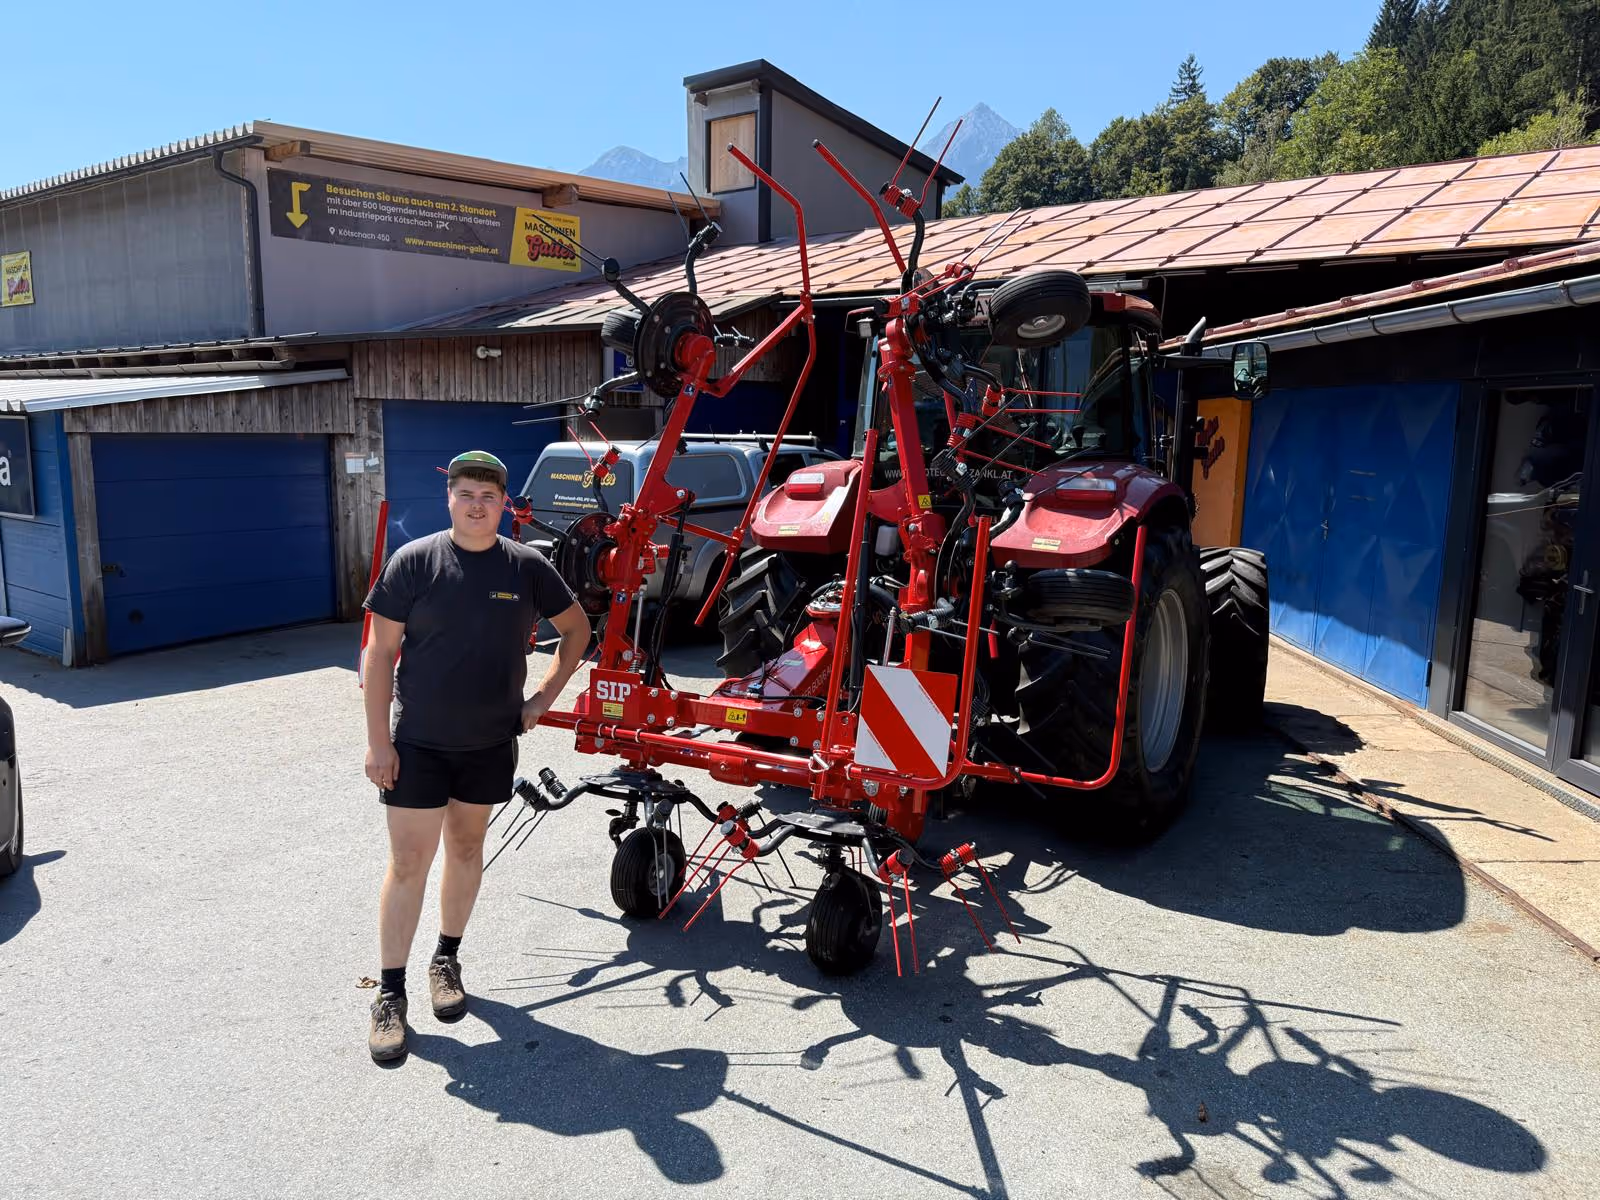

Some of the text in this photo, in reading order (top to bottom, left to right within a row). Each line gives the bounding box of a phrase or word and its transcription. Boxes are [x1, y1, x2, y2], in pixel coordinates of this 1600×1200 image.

[326, 184, 497, 217] Besuchen Sie uns auch am 2. Standort
[326, 196, 501, 228] mit über 500 lagernden Maschinen und Geräten
[340, 208, 393, 223] Industriepark
[393, 213, 433, 228] Kötschach
[338, 228, 390, 242] Kötschach 450
[524, 222, 576, 237] MASCHINEN
[404, 237, 498, 254] www.maschinen-gailer.at
[550, 473, 582, 482] MASCHINEN
[596, 680, 631, 702] SIP
